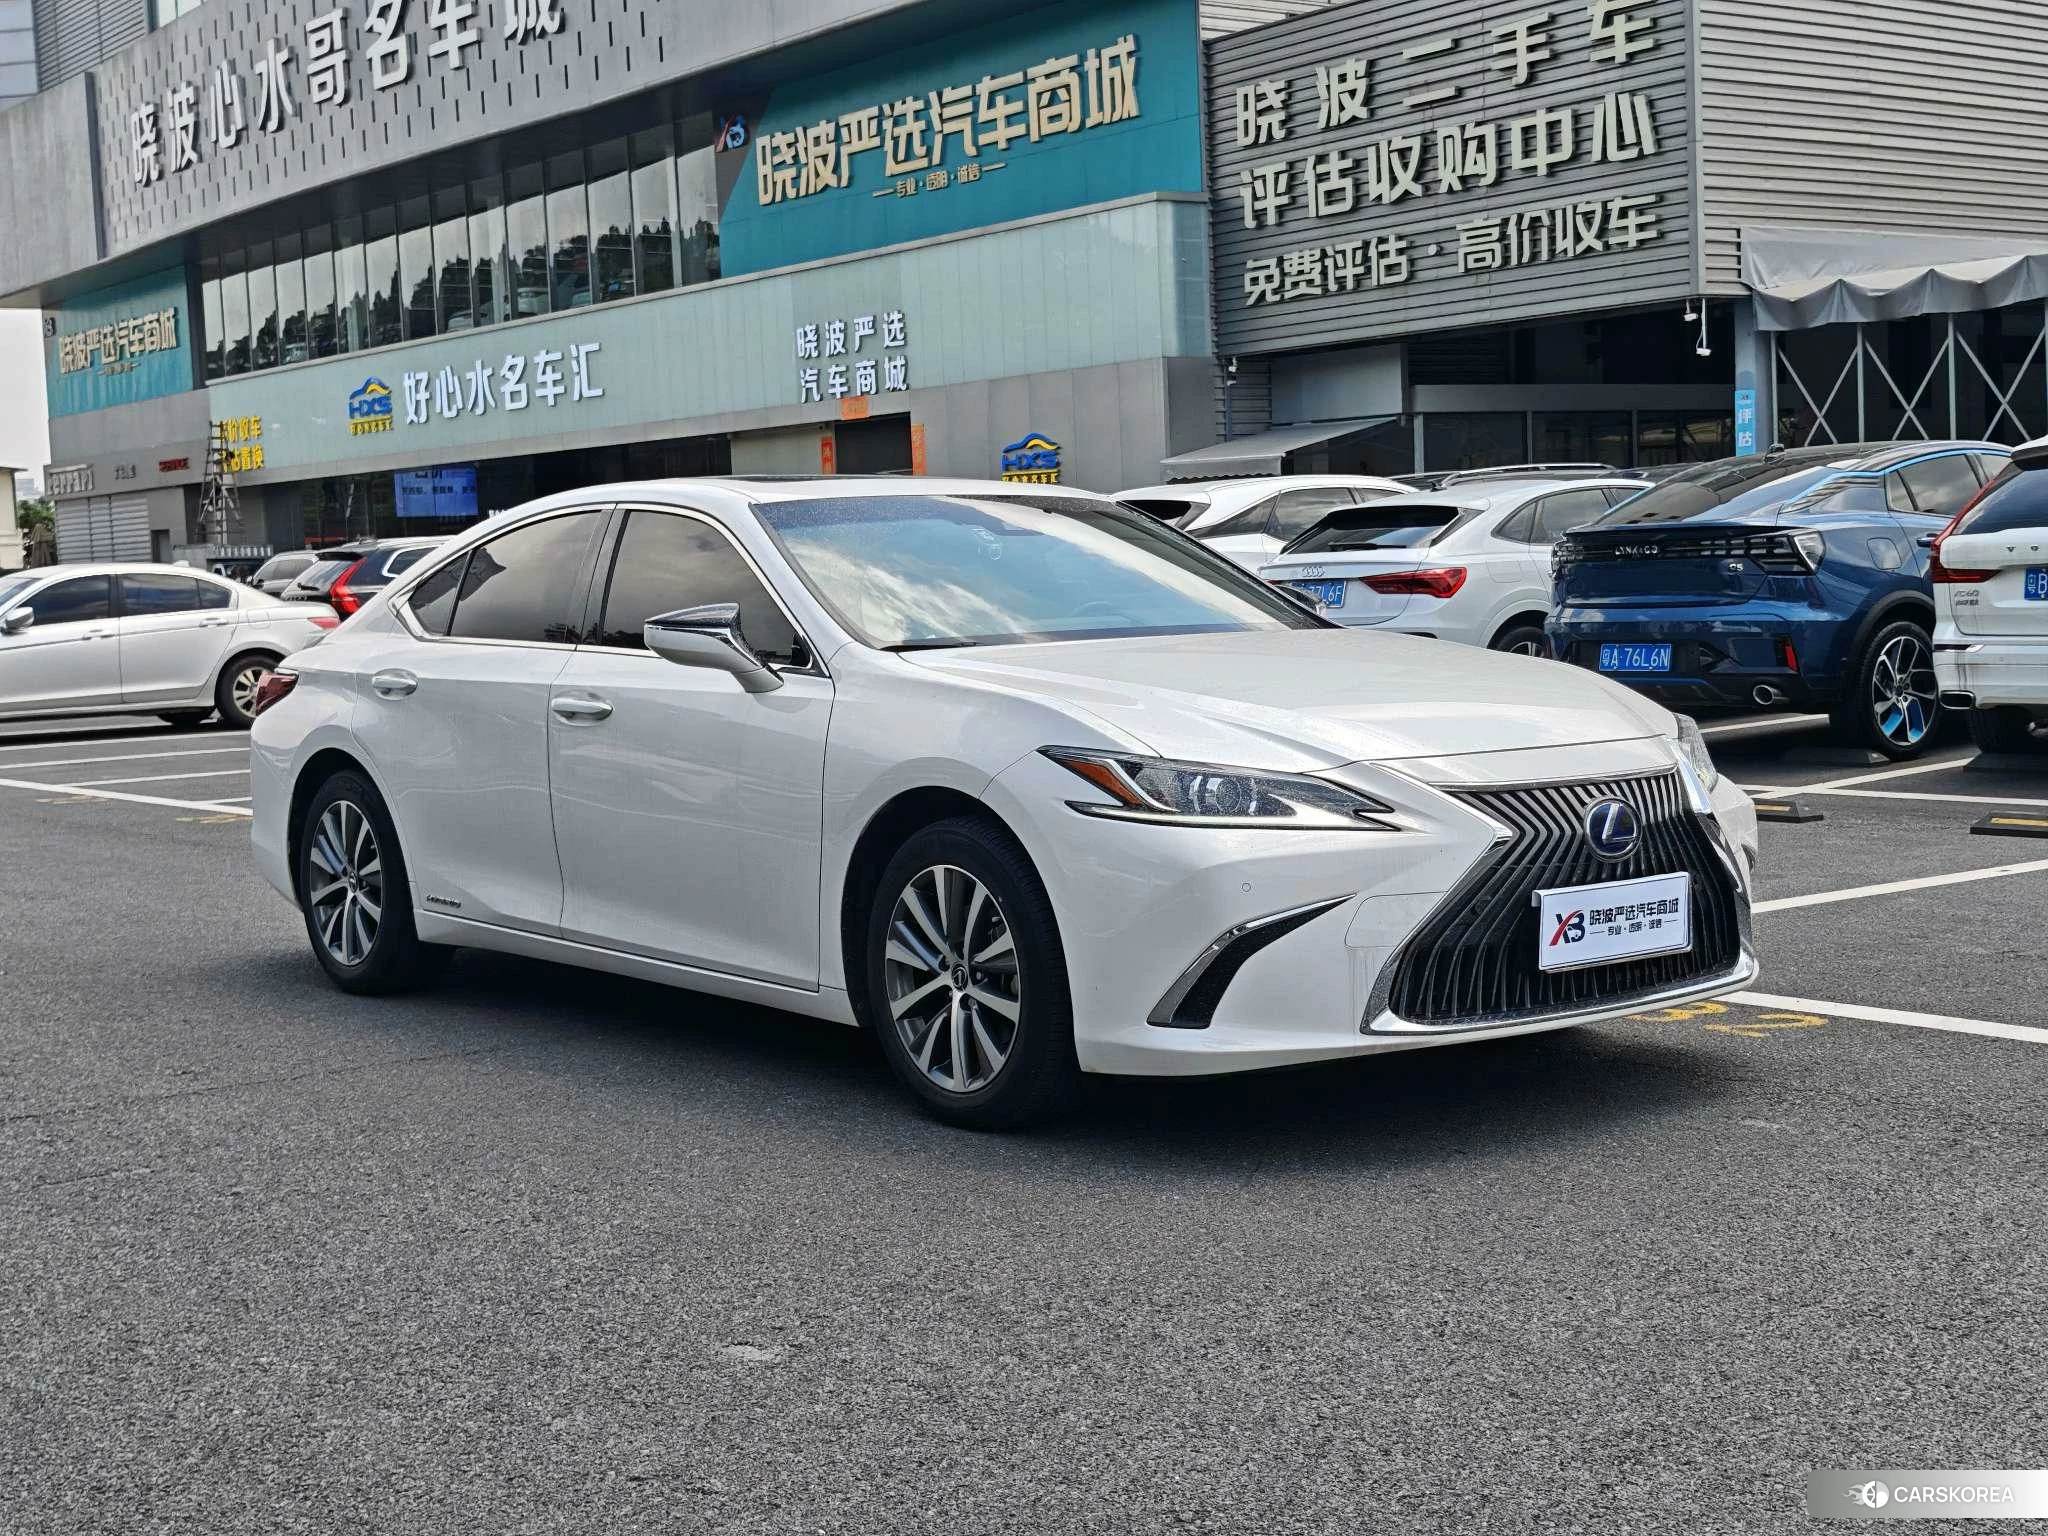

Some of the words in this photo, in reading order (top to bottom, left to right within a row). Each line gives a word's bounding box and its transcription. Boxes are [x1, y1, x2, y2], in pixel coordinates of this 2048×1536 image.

[756, 35, 1140, 205] 晓波严选汽车商城
[1236, 0, 1655, 146] 晓波二手车
[1240, 92, 1657, 228] 评估收购中心
[1244, 195, 1657, 304] 免费评估·高价收车
[796, 310, 905, 359] 晓波严选
[800, 355, 907, 403] 汽车商城
[403, 343, 604, 426] 好心水名车汇
[1589, 898, 1679, 926] 晓波严选汽车商城
